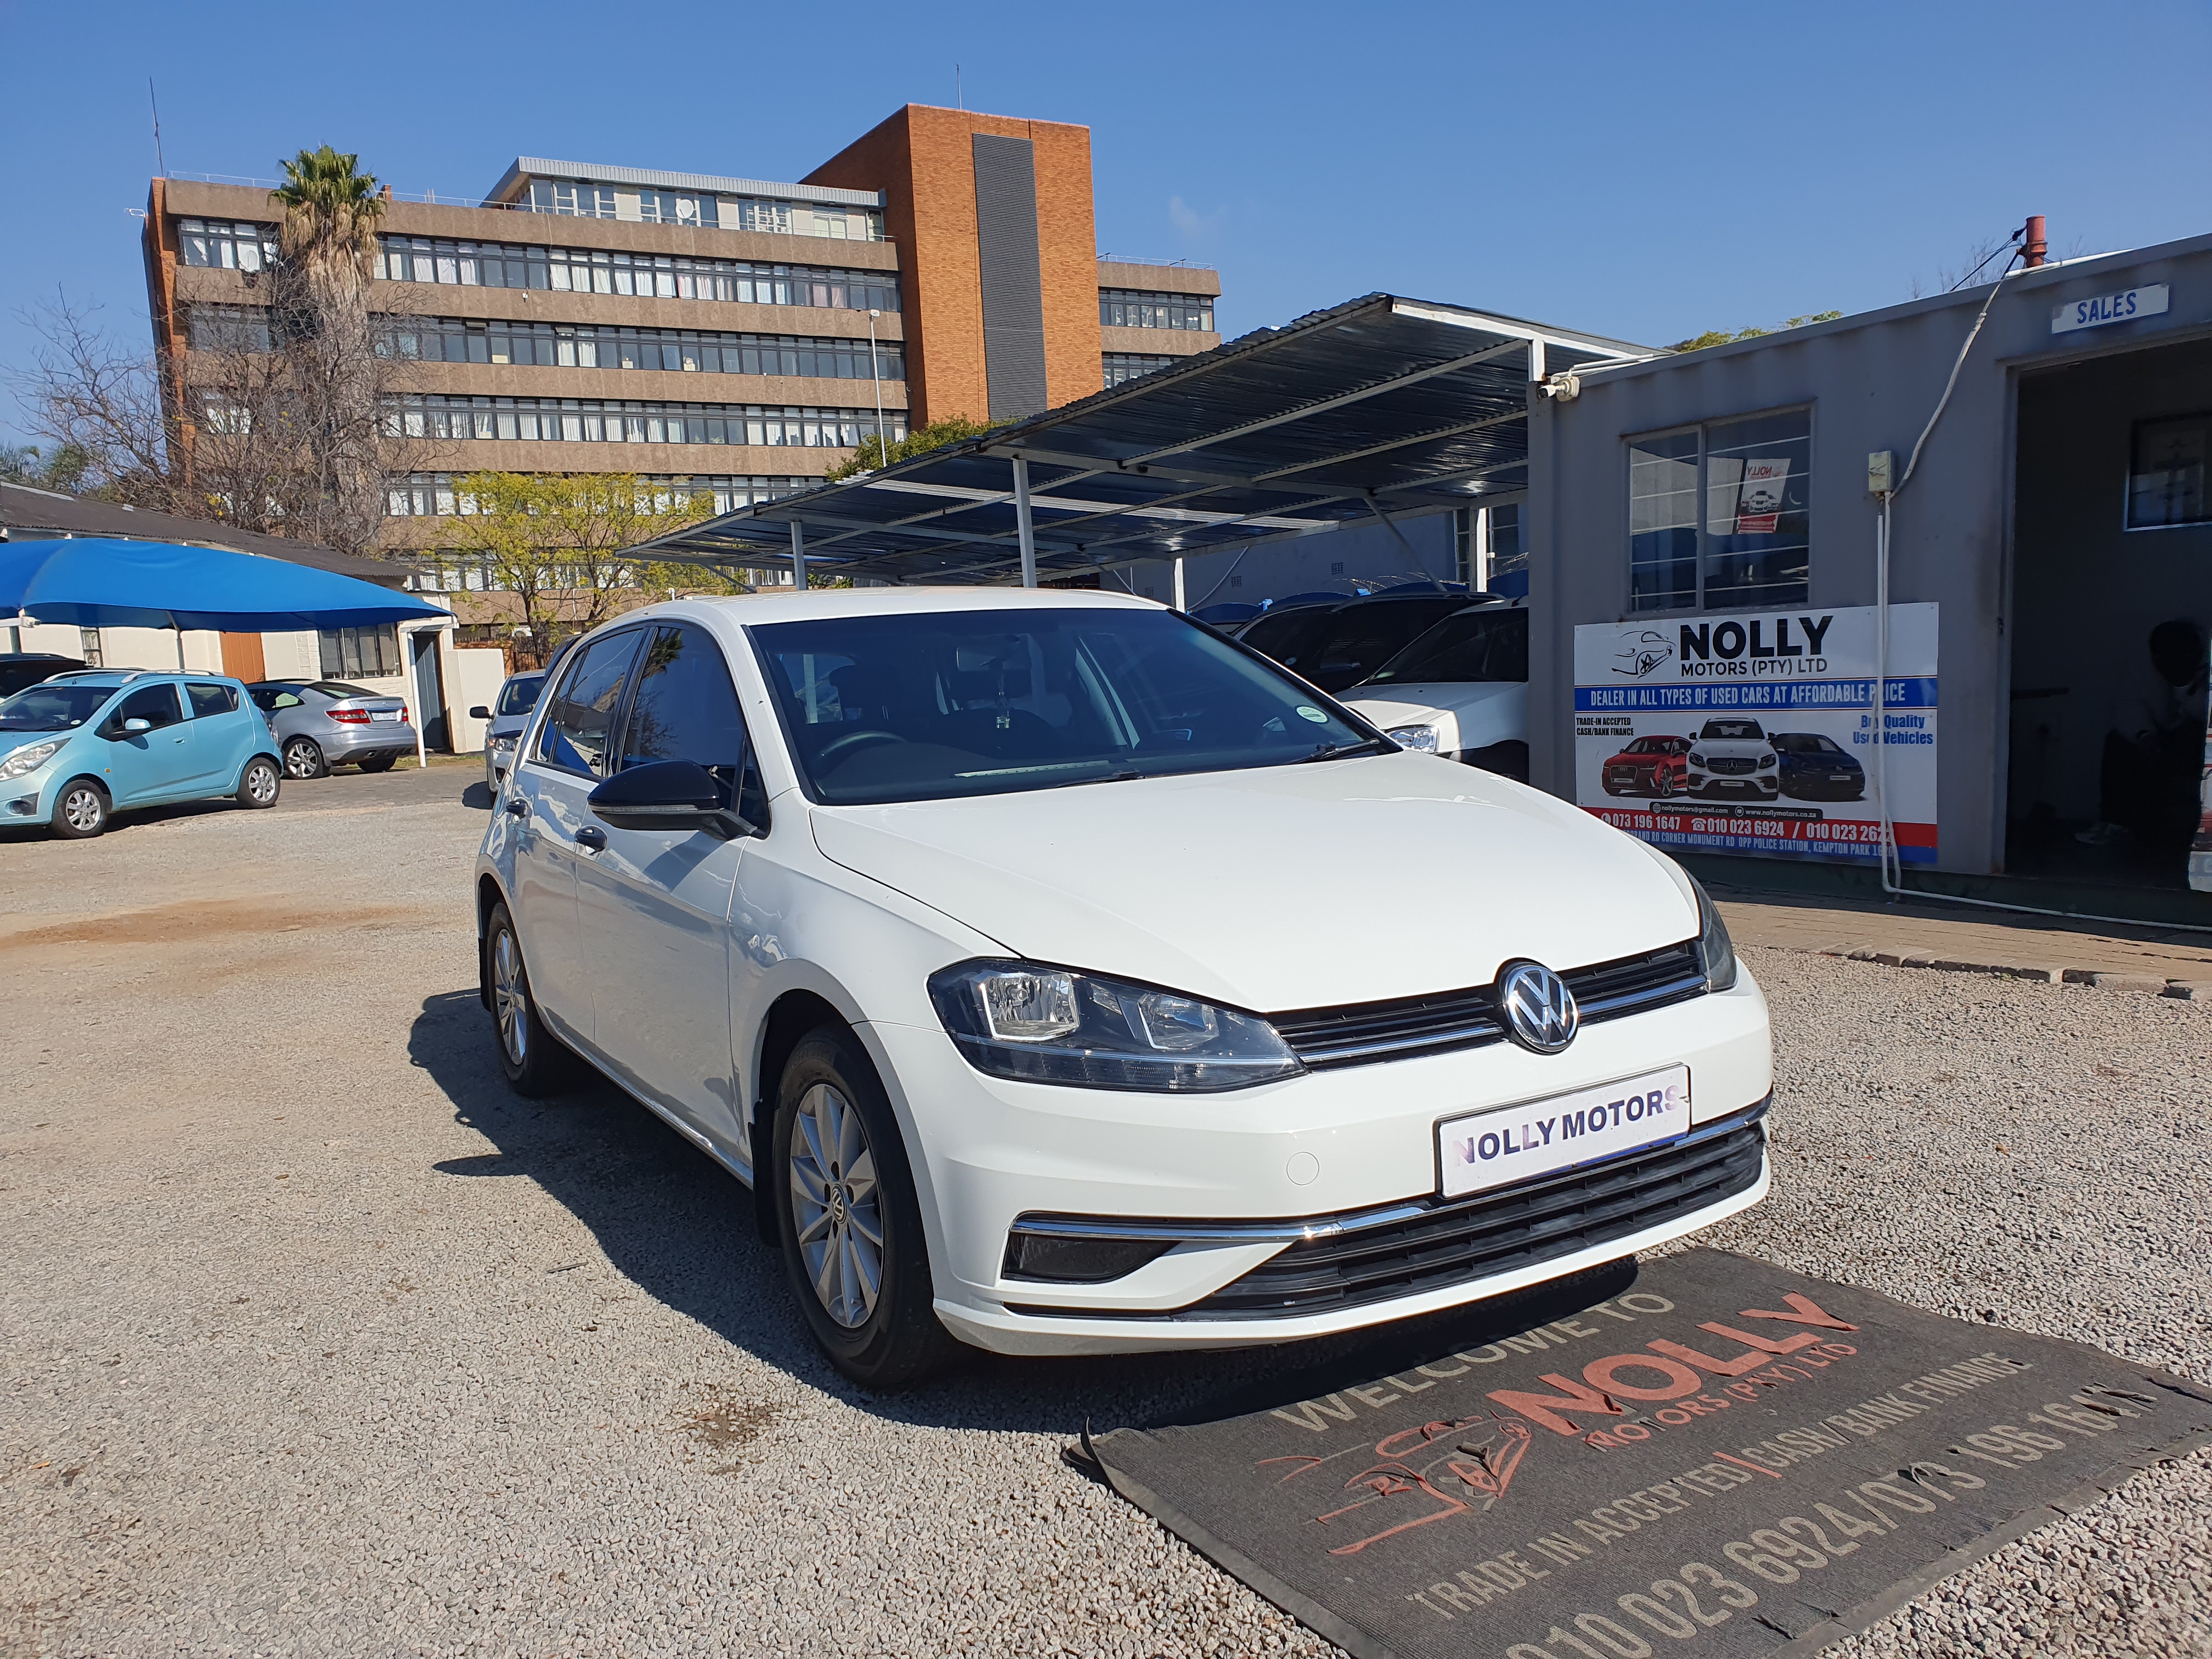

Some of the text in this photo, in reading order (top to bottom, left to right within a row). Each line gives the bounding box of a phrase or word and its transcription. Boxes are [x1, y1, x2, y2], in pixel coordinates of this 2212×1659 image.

[2077, 292, 2136, 324] SALES
[1680, 616, 1833, 661] NOLLY
[1681, 658, 1827, 676] MOTORS (PTY) LTD
[1591, 683, 1905, 706] DEALER IN ALL TYPES OF USED CARS AT AFFORDABLE PICE
[1576, 717, 1631, 726] TRADE-IN ACCEPTED
[1576, 727, 1634, 736] CASH/BANK FINANCE
[1884, 715, 1925, 729] Quality
[1883, 731, 1933, 744] Vehicles
[1661, 805, 1728, 814] nollymotors@gmail.com
[1746, 809, 1816, 818] www.nollymotors.co.za
[1613, 813, 1631, 827] 073
[1634, 814, 1652, 829] 196
[1656, 816, 1680, 830] 1647
[1707, 818, 1728, 832] 010
[1730, 819, 1752, 835] 023
[1755, 821, 1784, 837] 6924
[1807, 823, 1829, 839] 010
[1832, 824, 1857, 840] 023
[1651, 832, 1660, 842] RD
[1661, 832, 1685, 844] CORNER
[1687, 834, 1724, 847] MONUMENT
[1726, 836, 1735, 847] RD
[1739, 837, 1751, 848] OPP
[1753, 838, 1778, 850] POLICE
[1779, 839, 1810, 854] STATION,
[1813, 841, 1848, 854] KEMPTON
[1850, 843, 1870, 856] PARK
[1269, 1293, 1675, 1431] WELCOME TO
[1486, 1290, 1860, 1436] NOLLY
[1582, 1344, 1858, 1453] MOTORS (PTY) LTD
[1403, 1352, 2034, 1620] TRADE IN ACCEPTED CASH/BANK FINANCE
[1618, 1562, 1759, 1640] 023
[1949, 1425, 2066, 1470] 196
